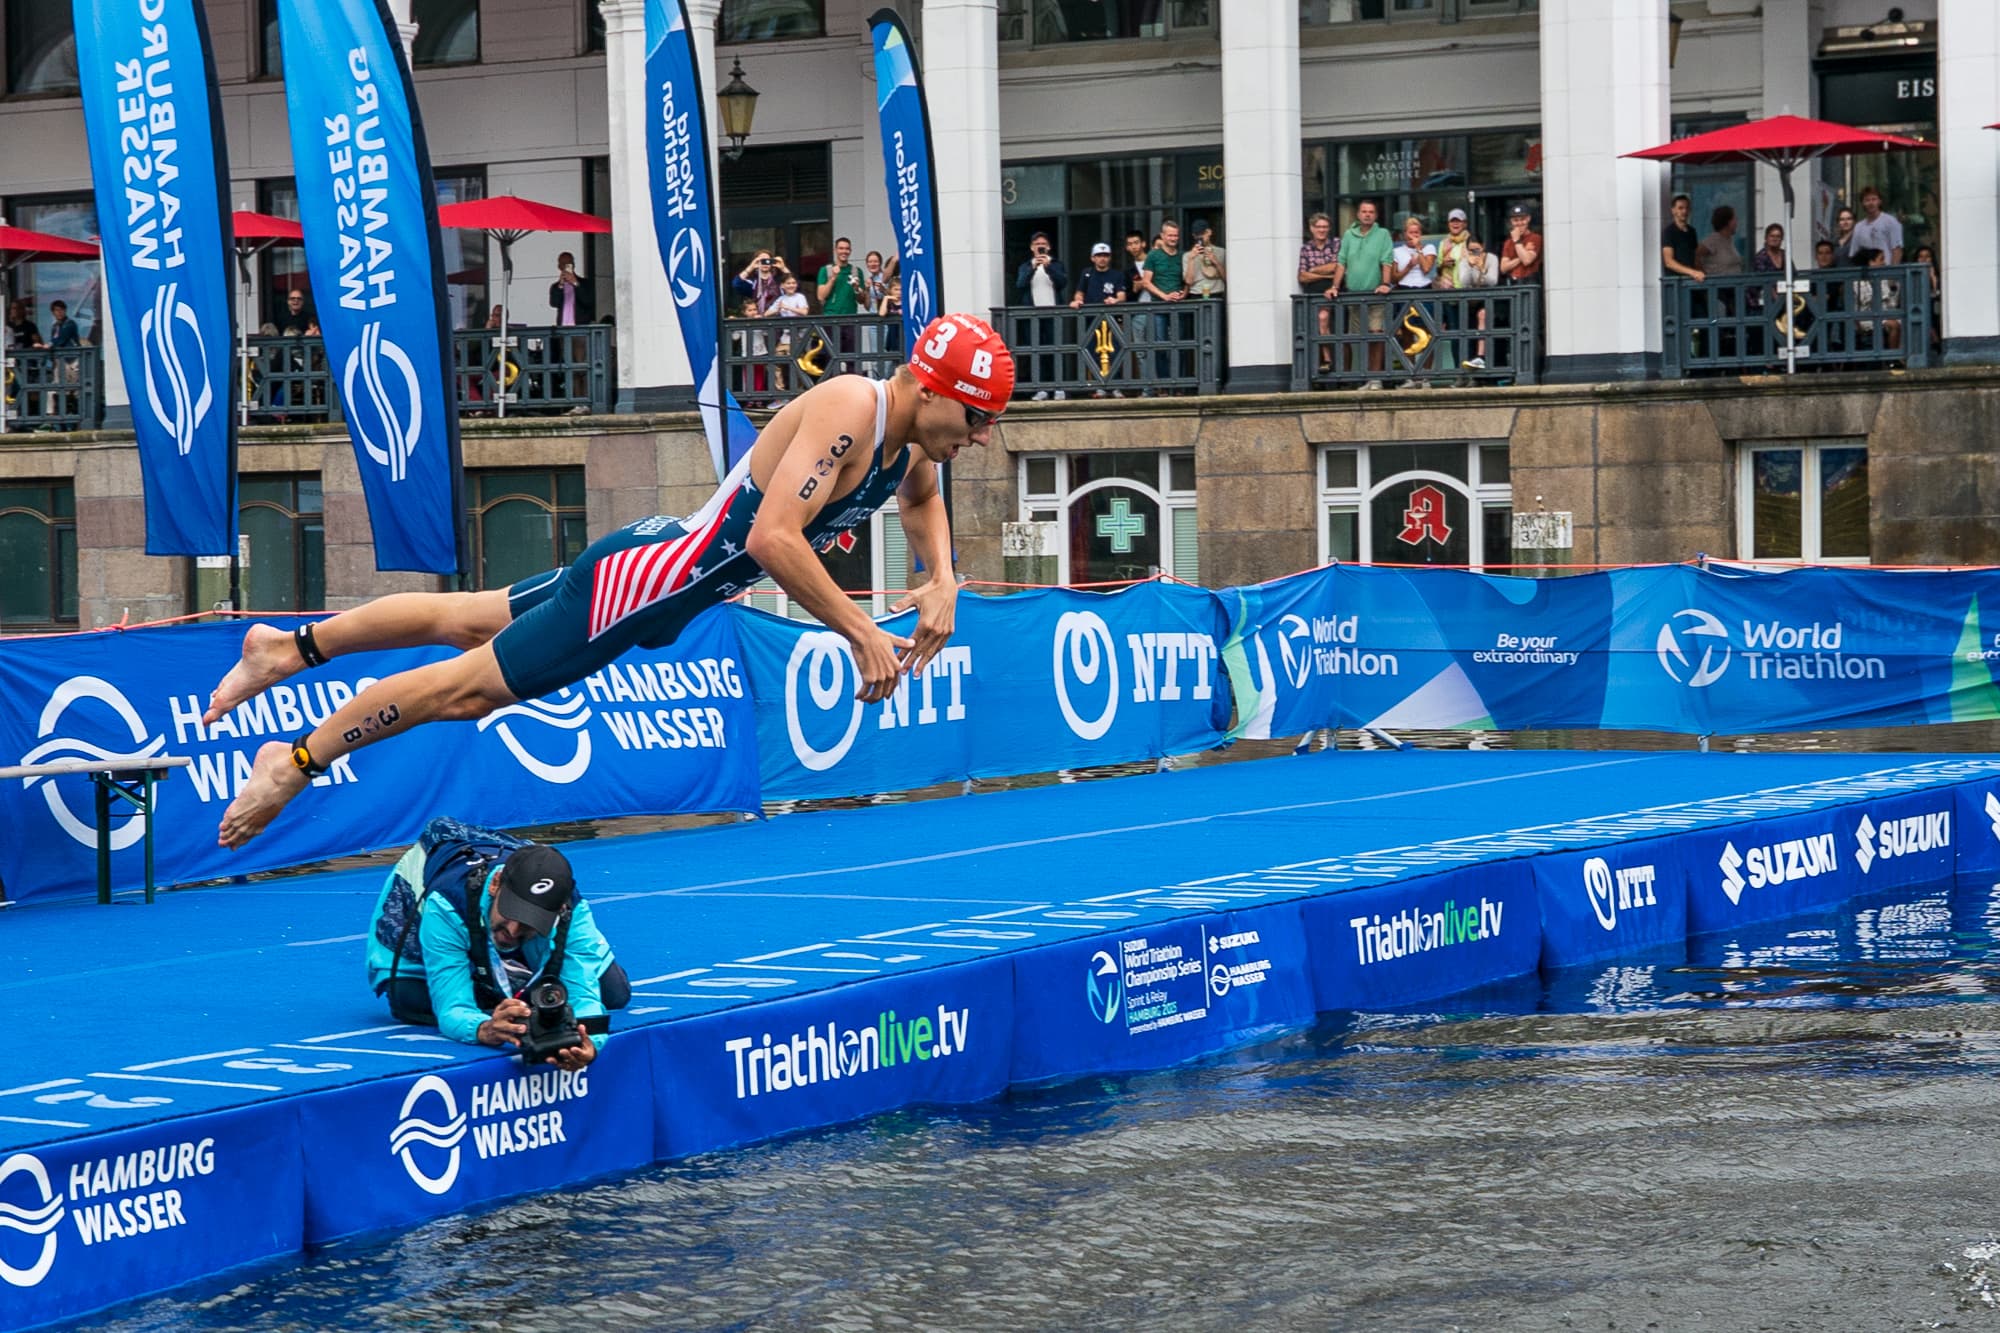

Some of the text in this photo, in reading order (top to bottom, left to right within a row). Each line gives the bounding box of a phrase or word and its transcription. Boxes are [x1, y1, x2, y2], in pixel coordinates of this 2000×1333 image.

[1897, 78, 1935, 98] EIS
[1366, 161, 1421, 172] ARKADEN
[1377, 151, 1420, 161] ALSTER
[1360, 170, 1421, 182] APOTHEKE
[924, 321, 958, 359] 3
[970, 349, 993, 379] B
[830, 434, 855, 459] 3
[797, 476, 819, 502] B
[1312, 615, 1358, 644] World
[1496, 633, 1558, 652] Be your
[1743, 620, 1842, 650] World
[1126, 632, 1218, 703] NTT
[1313, 646, 1398, 676] Triathlon
[1472, 648, 1580, 666] extraordinary
[1741, 651, 1885, 680] Triathlon
[584, 657, 744, 702] HAMBURG
[168, 676, 380, 744] HAMBUR
[378, 703, 401, 727] 3
[342, 726, 363, 743] B
[600, 707, 727, 750] WASSER
[1879, 810, 1950, 860] SUZUKI
[1746, 833, 1837, 889] SUZUKI
[1615, 864, 1657, 911] NTT
[1219, 930, 1260, 949] SUZUKI
[1124, 945, 1183, 968] World Triathlon
[1229, 959, 1271, 976] HAMBURG
[1125, 957, 1202, 988] Championship Series
[1232, 971, 1266, 987] WASSER
[471, 1065, 589, 1119] HAMBURG
[472, 1110, 567, 1160] WASSER
[69, 1137, 216, 1201] HAMBURG
[72, 1189, 187, 1246] WASSER
